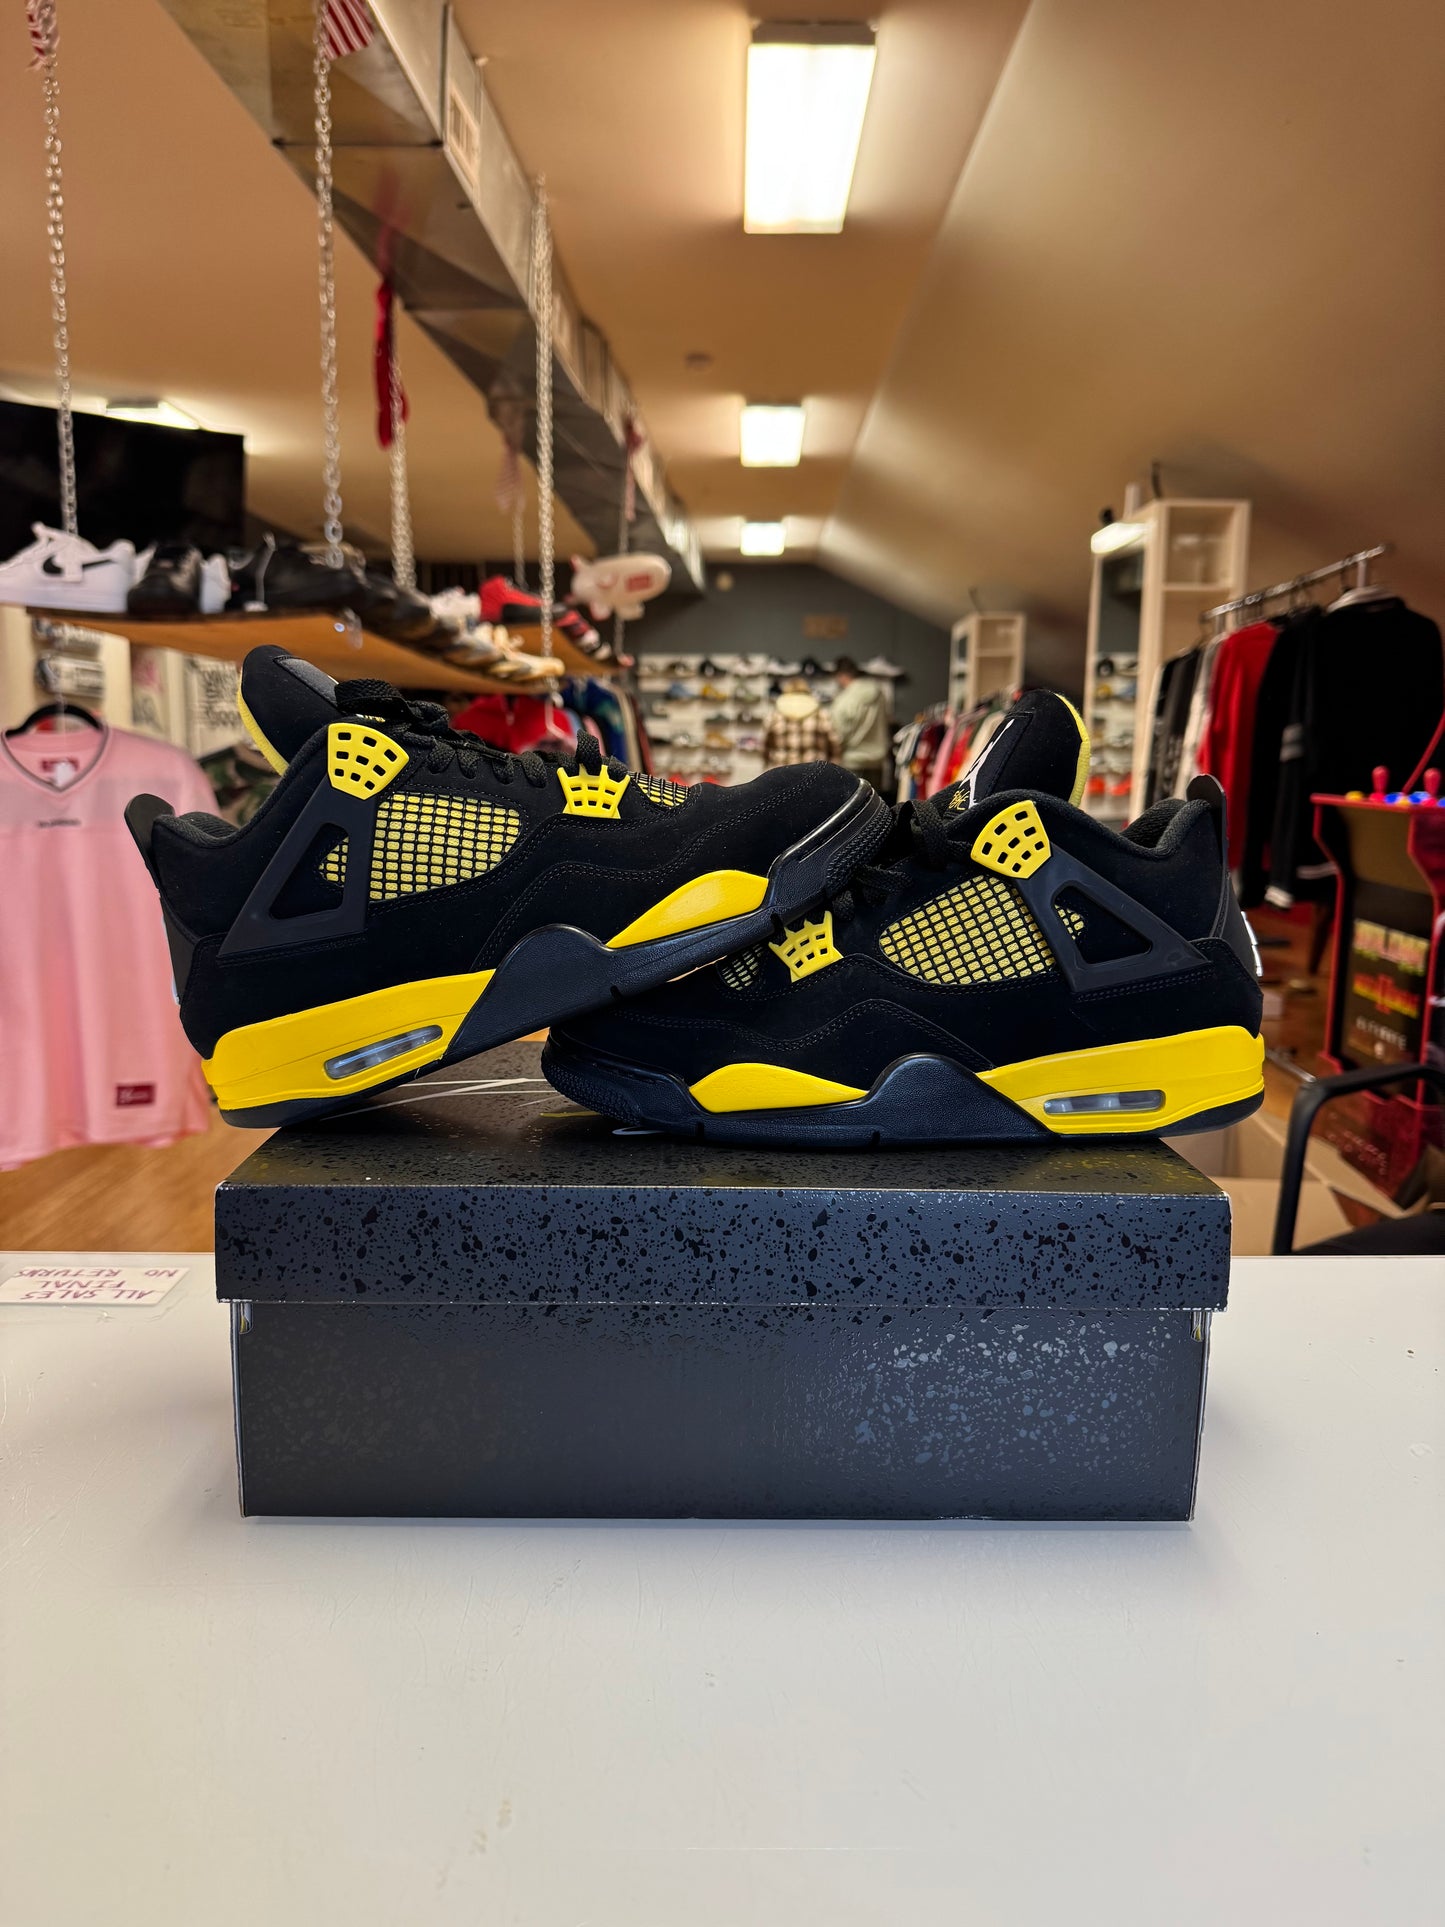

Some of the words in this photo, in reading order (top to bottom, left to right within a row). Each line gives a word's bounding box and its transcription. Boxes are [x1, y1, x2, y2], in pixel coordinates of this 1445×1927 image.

[16, 1269, 122, 1278] RETURNS
[144, 1269, 179, 1278] NO
[39, 1280, 126, 1289] FINAL
[20, 1290, 98, 1300] SALES
[112, 1290, 154, 1300] ALL
